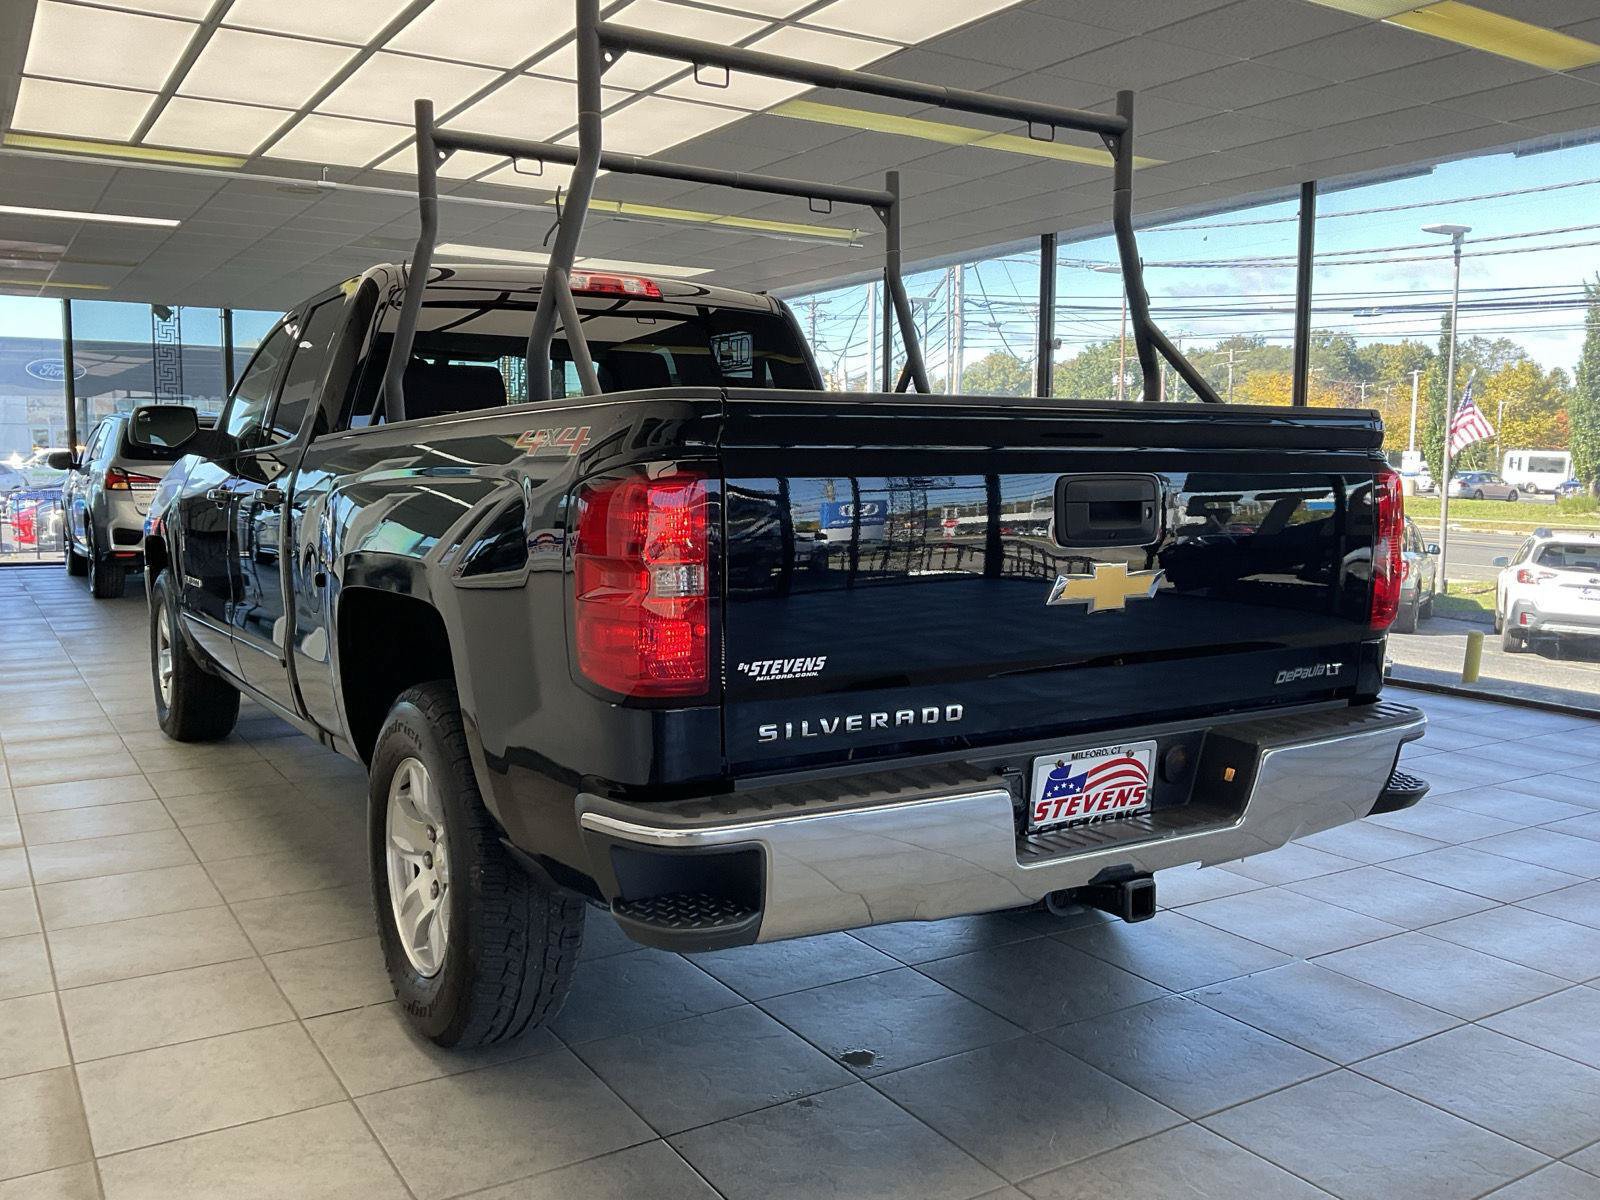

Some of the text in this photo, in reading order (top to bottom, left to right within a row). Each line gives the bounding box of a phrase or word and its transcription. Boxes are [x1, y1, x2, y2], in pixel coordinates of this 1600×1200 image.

[748, 656, 827, 676] STEVENS
[1326, 662, 1343, 676] LT
[758, 703, 963, 742] SILVERADO
[1111, 746, 1122, 755] CT
[1034, 786, 1148, 822] STEVENS
